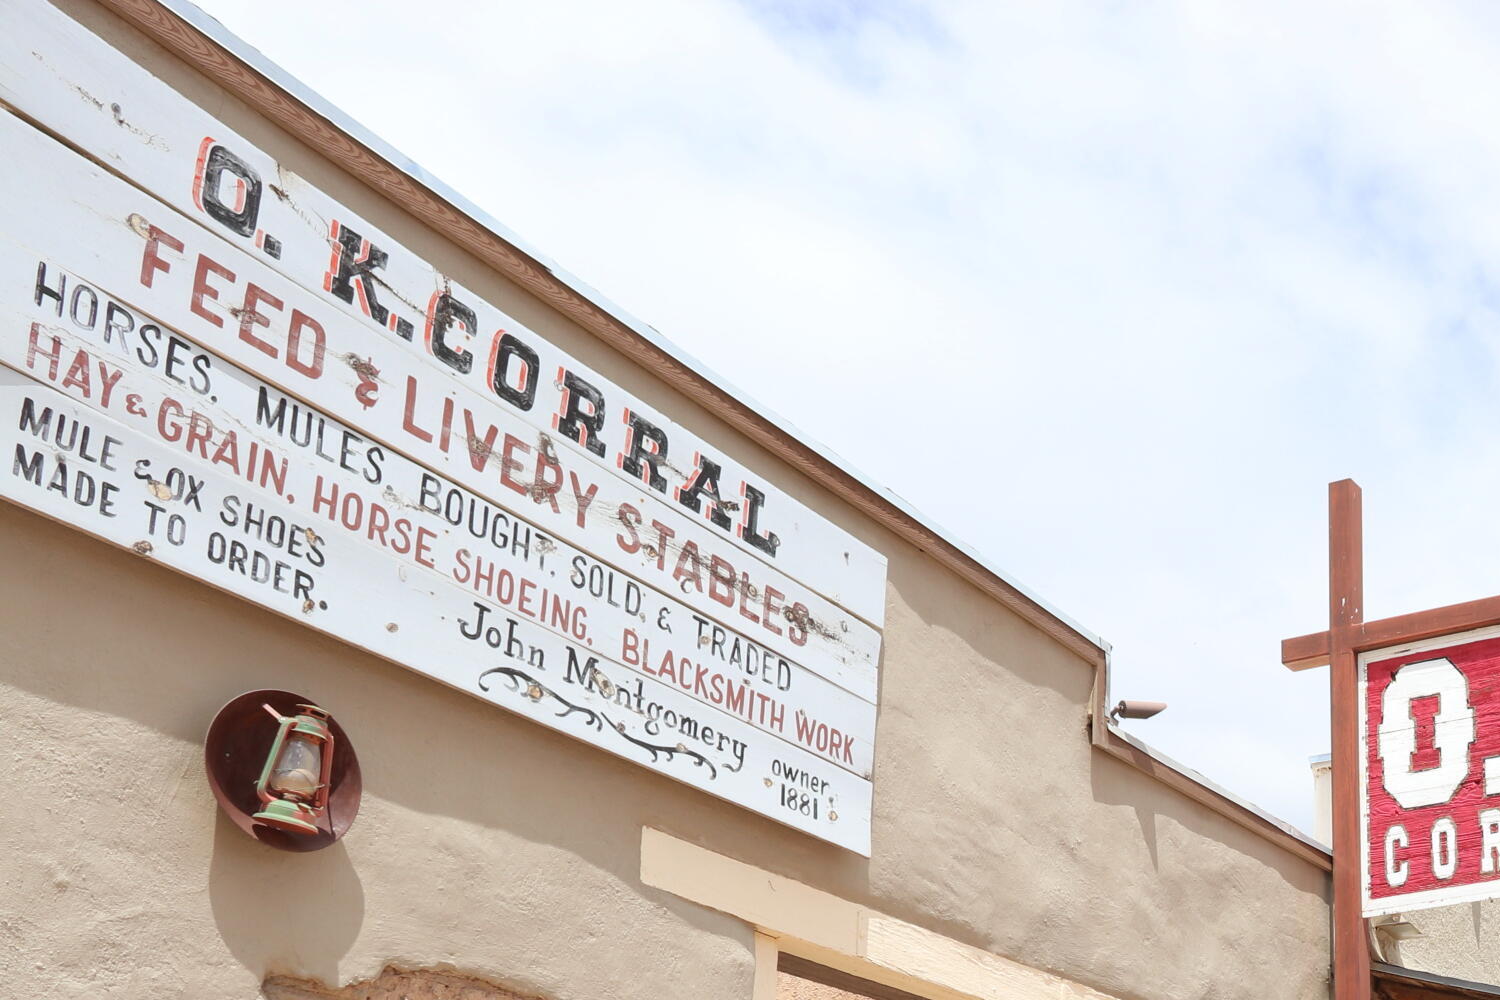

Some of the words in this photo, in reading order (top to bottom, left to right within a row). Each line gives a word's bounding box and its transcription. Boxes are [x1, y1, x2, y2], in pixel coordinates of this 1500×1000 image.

[192, 136, 282, 261] O.
[323, 219, 414, 343] K.
[424, 290, 779, 558] CORRAL
[18, 397, 123, 472] MULE
[166, 467, 204, 512] OX
[219, 495, 325, 568] SHOES
[139, 224, 327, 380] FEED
[403, 375, 598, 528] LIVERY
[616, 503, 809, 647] STABLES
[12, 443, 120, 518] MADE
[144, 500, 186, 546] TO
[207, 531, 328, 610] ORDER.
[26, 321, 123, 409] HAY
[126, 393, 147, 417] &
[157, 396, 295, 504] GRAIN,
[313, 475, 437, 569] HORSE
[453, 548, 593, 646] SHOEING,
[622, 627, 786, 734] BLACKSMITH
[795, 710, 854, 766] WORK
[458, 601, 546, 671] John
[657, 606, 672, 634] &
[692, 614, 792, 692] TRADED
[772, 759, 830, 795] owner
[780, 783, 818, 820] 1881
